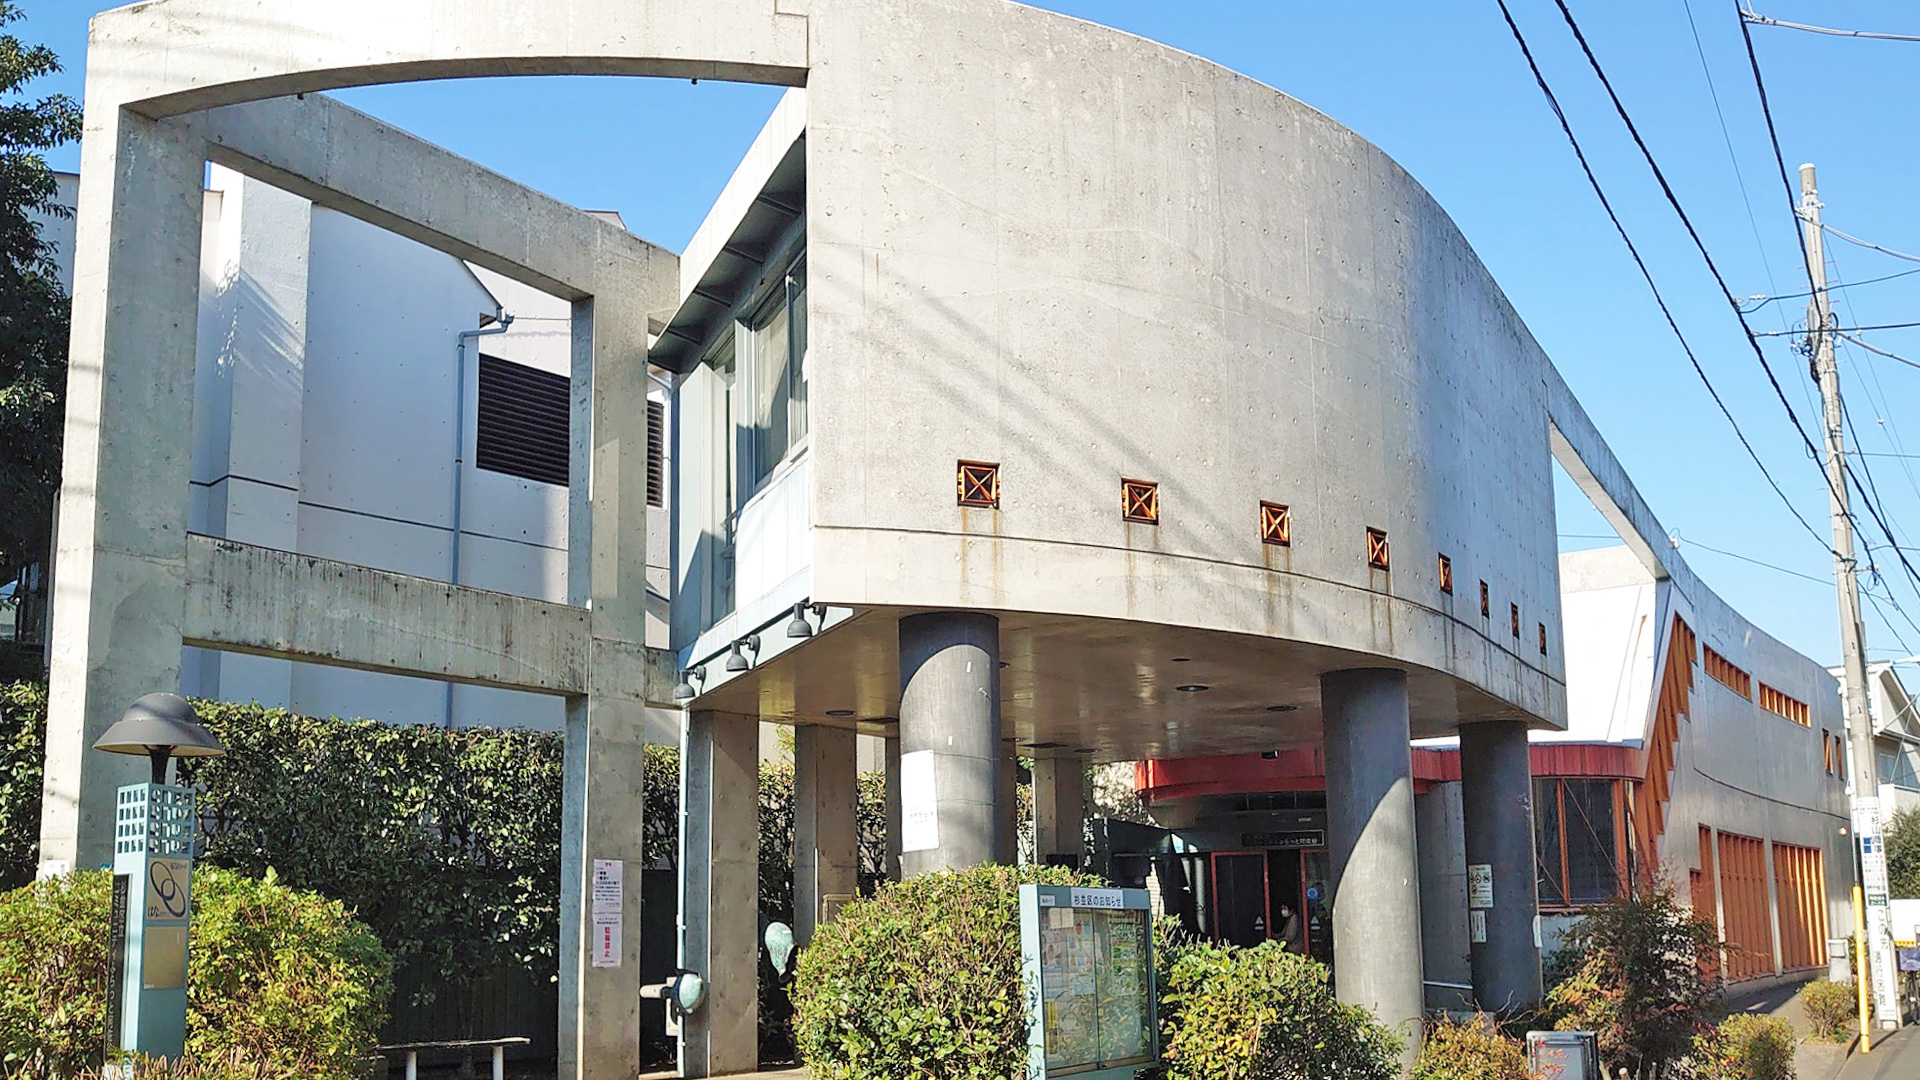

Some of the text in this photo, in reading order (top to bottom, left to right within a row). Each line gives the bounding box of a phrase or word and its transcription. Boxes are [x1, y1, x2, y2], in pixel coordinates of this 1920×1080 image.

[1073, 894, 1122, 907] 杉並区のお知らせ
